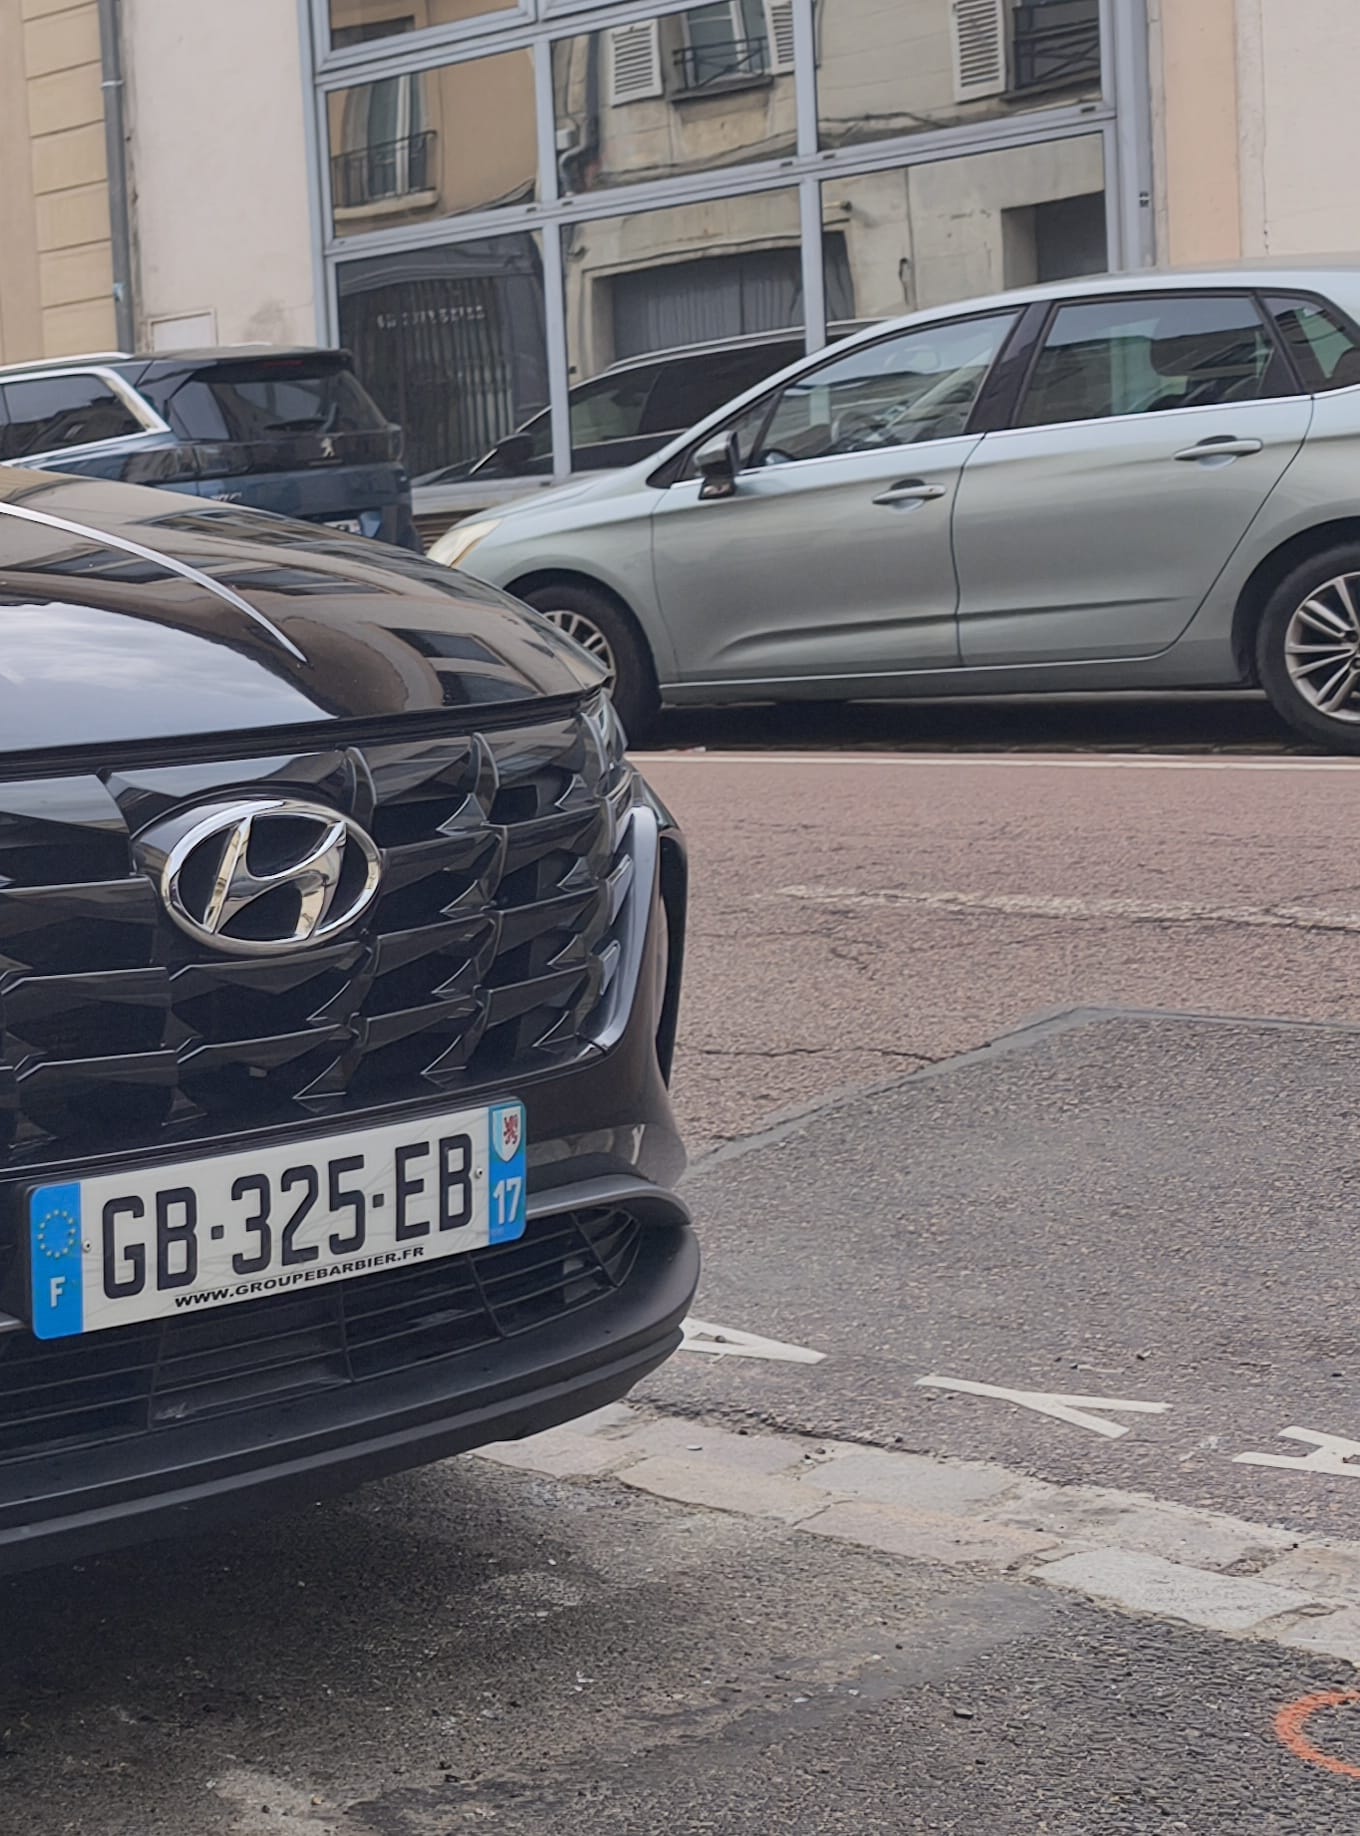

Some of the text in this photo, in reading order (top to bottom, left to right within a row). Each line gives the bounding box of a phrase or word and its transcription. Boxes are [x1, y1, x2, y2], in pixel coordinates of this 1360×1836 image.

[492, 1176, 522, 1225] 17
[49, 1276, 66, 1308] F
[175, 1246, 425, 1308] WWW.GROUPEBARBIER.FR
